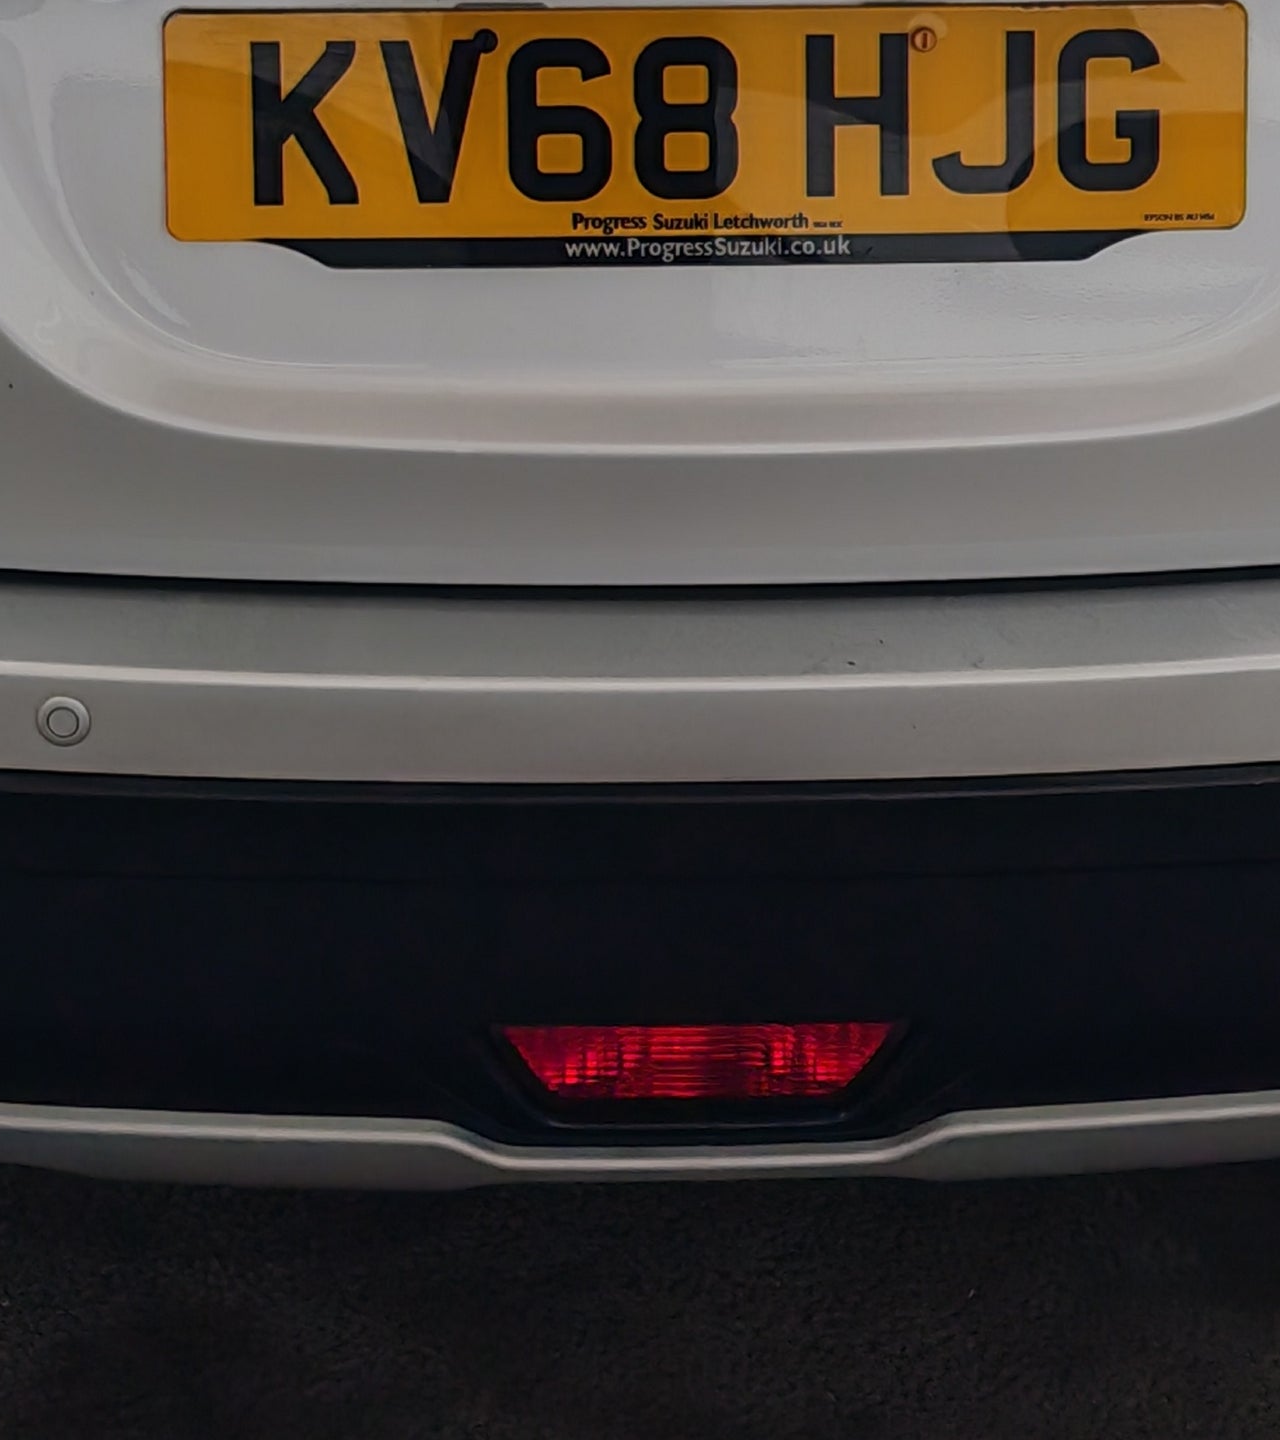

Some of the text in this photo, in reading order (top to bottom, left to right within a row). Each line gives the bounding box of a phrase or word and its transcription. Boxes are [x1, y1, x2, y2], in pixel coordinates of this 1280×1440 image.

[249, 28, 1164, 208] KV68 HJG
[571, 212, 648, 235] Progress
[652, 212, 709, 231] Suzuki
[713, 212, 809, 231] Letchworth
[564, 236, 852, 262] www.ProgressSuzuki.co.uk
